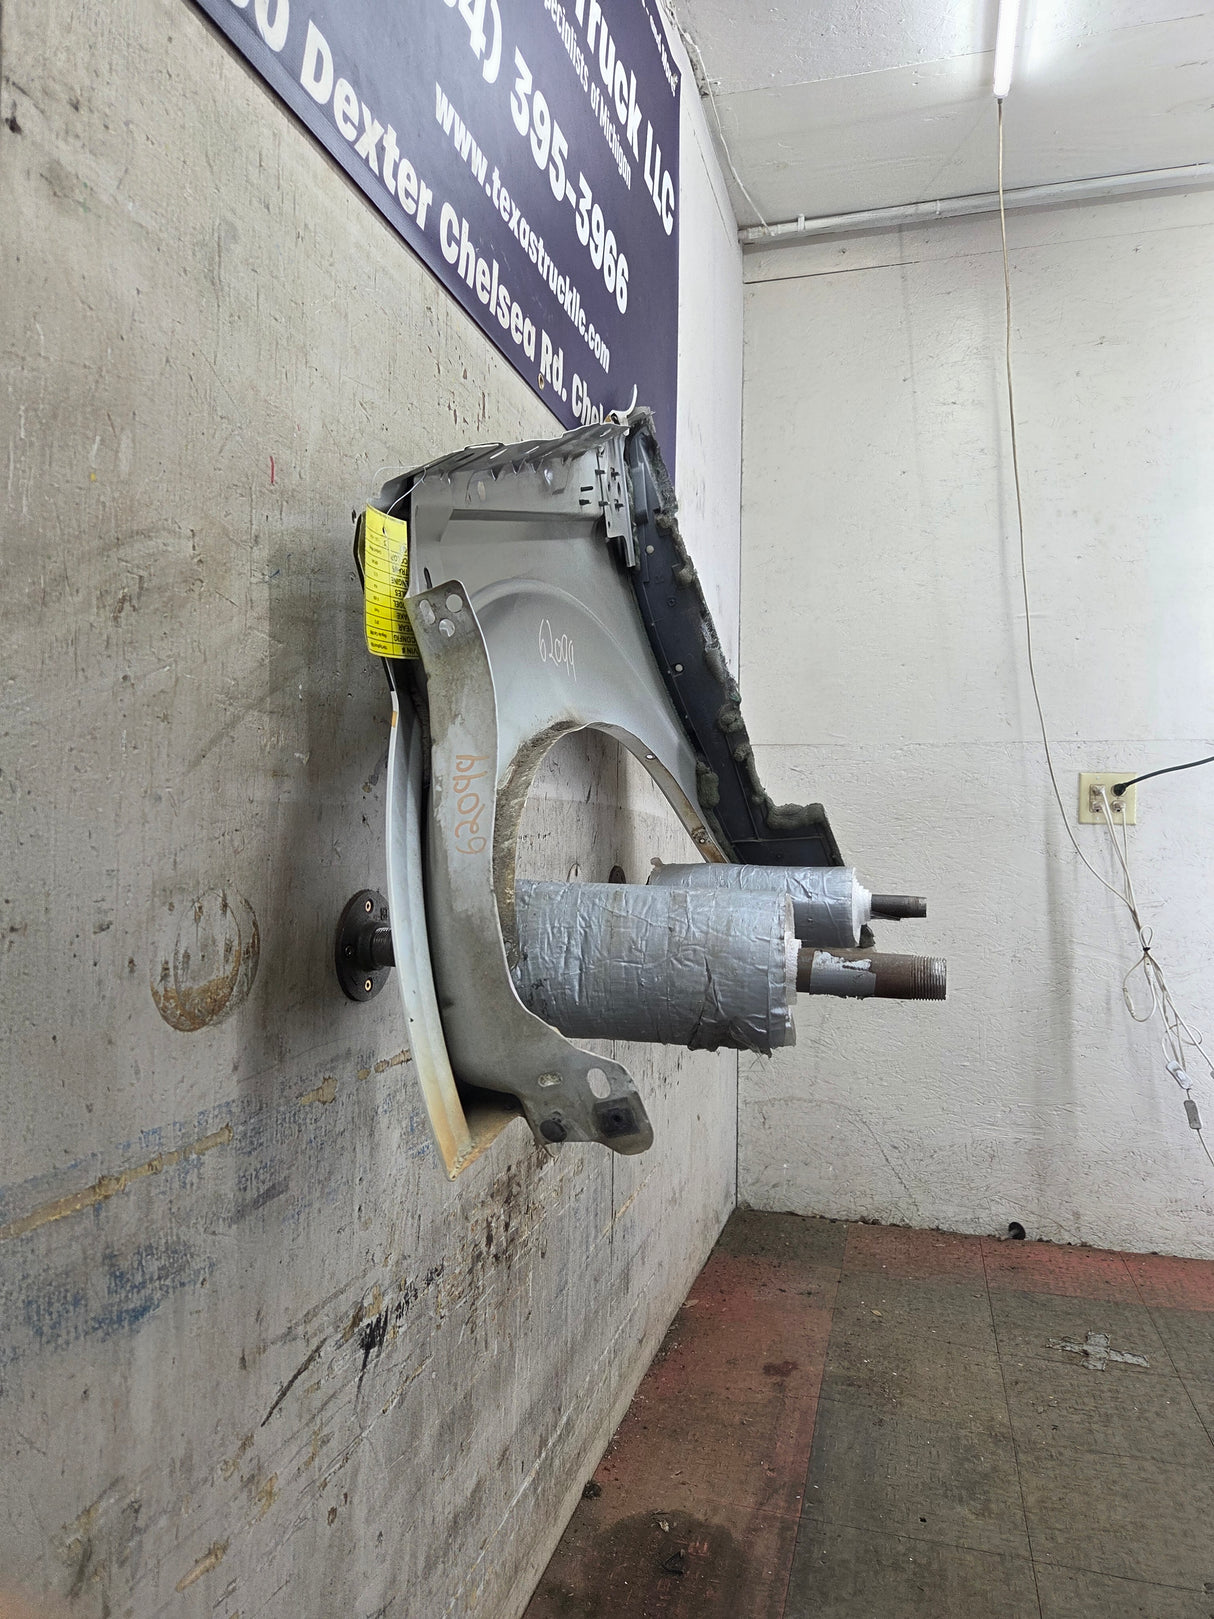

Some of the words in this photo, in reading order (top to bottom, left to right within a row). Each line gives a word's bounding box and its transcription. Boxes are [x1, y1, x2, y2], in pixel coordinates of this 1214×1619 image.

[228, 0, 290, 52] 0
[301, 19, 433, 231] Dexter
[439, 202, 536, 362] Chelsea
[540, 331, 567, 402] Rd.
[435, 81, 610, 374] www.texastruckllc.com
[443, 0, 503, 84] 4)
[509, 46, 629, 314] 395-3966
[590, 81, 601, 117] of
[600, 96, 631, 190] Michigan
[643, 119, 675, 236] LLC
